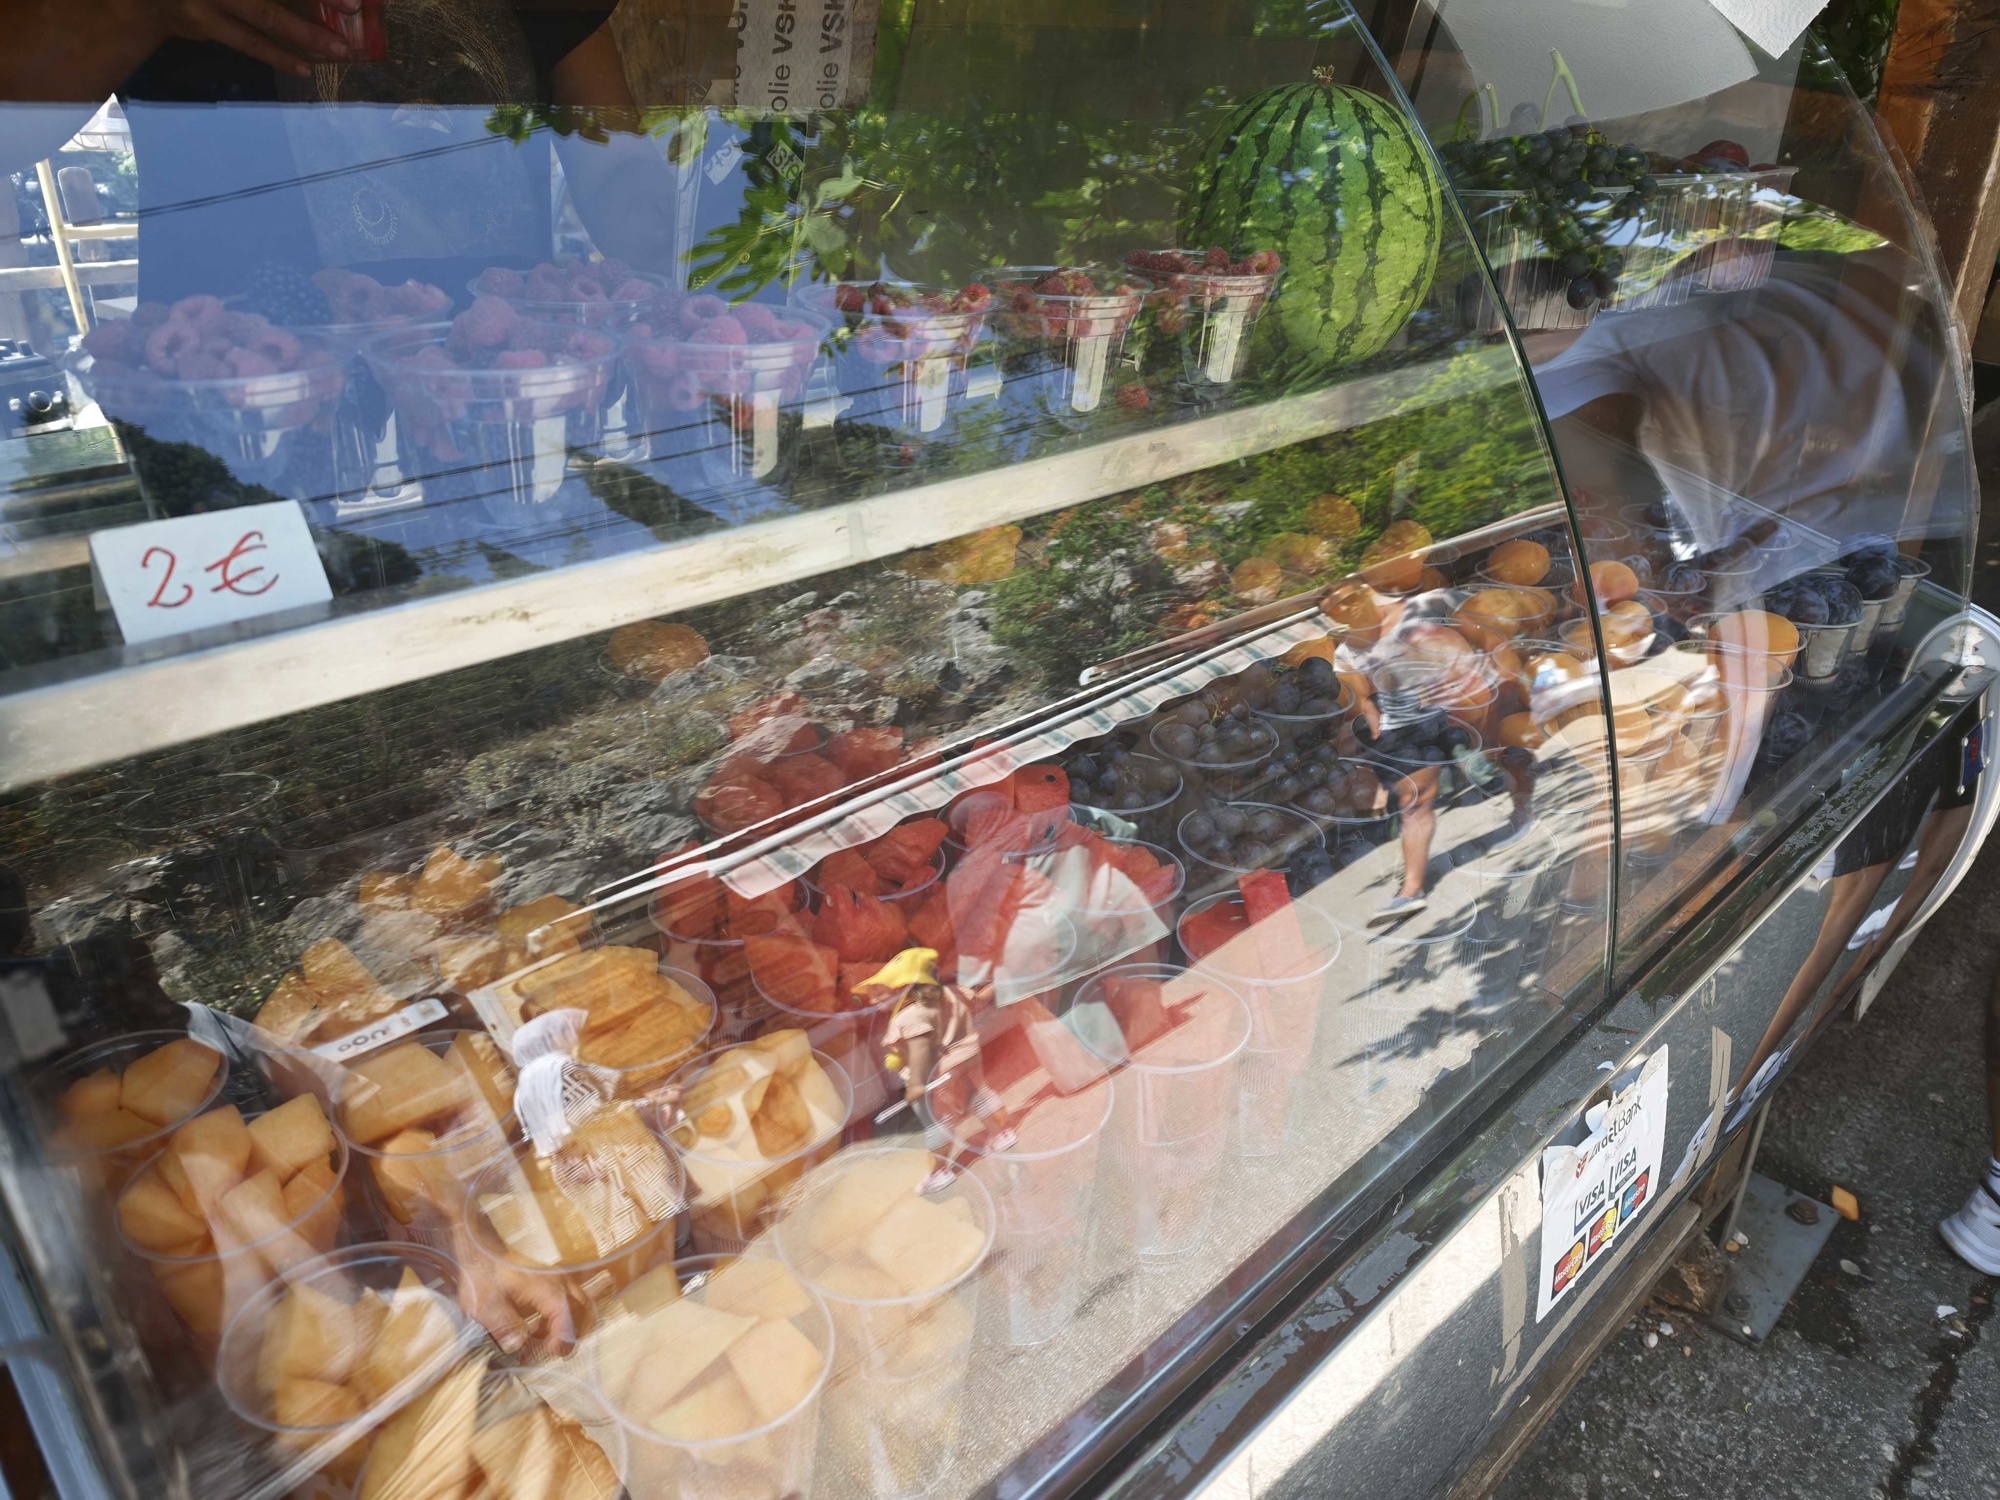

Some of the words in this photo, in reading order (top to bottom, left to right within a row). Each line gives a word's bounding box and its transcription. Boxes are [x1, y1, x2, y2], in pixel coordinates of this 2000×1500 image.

[768, 64, 791, 117] olie
[816, 63, 839, 114] olie
[141, 546, 194, 608] 2
[204, 531, 280, 596] €
[1580, 1179, 1605, 1215] VISA
[1615, 1147, 1637, 1180] VISA
